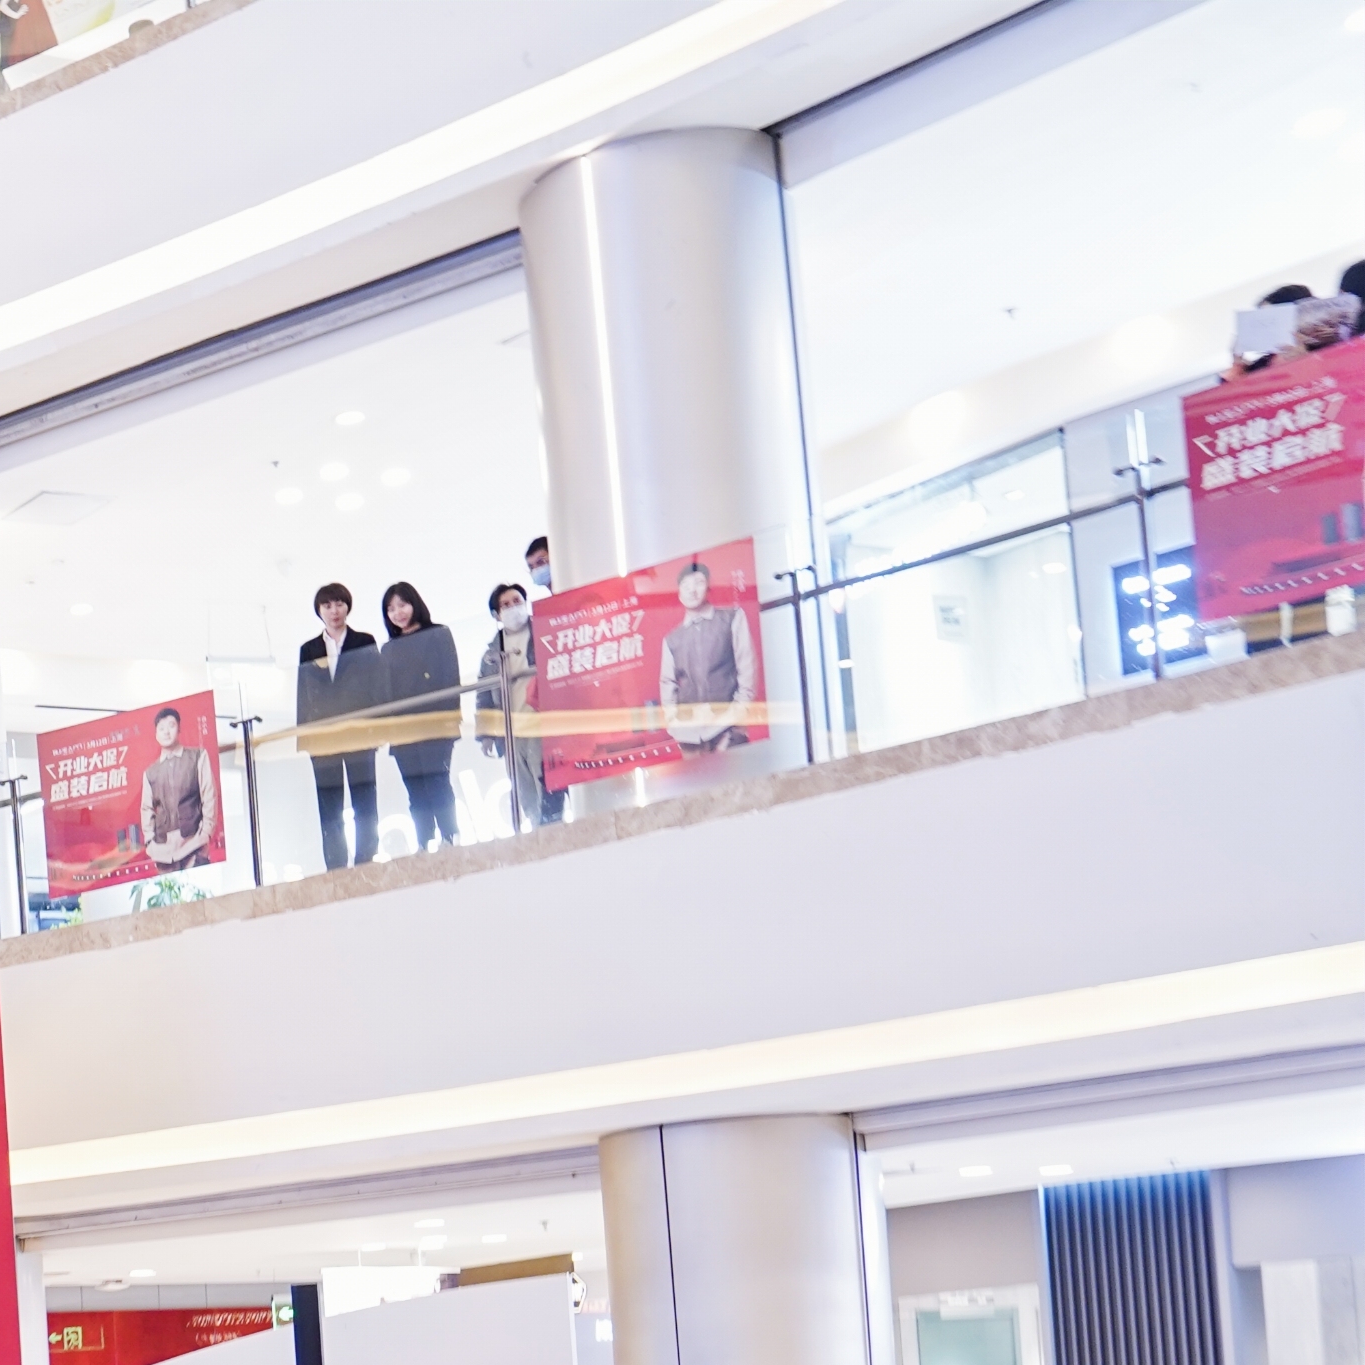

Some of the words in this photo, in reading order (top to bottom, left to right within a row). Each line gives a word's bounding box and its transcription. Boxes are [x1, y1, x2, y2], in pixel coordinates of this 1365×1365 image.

[57, 747, 117, 779] 开业大促
[50, 766, 128, 803] 盛装启航
